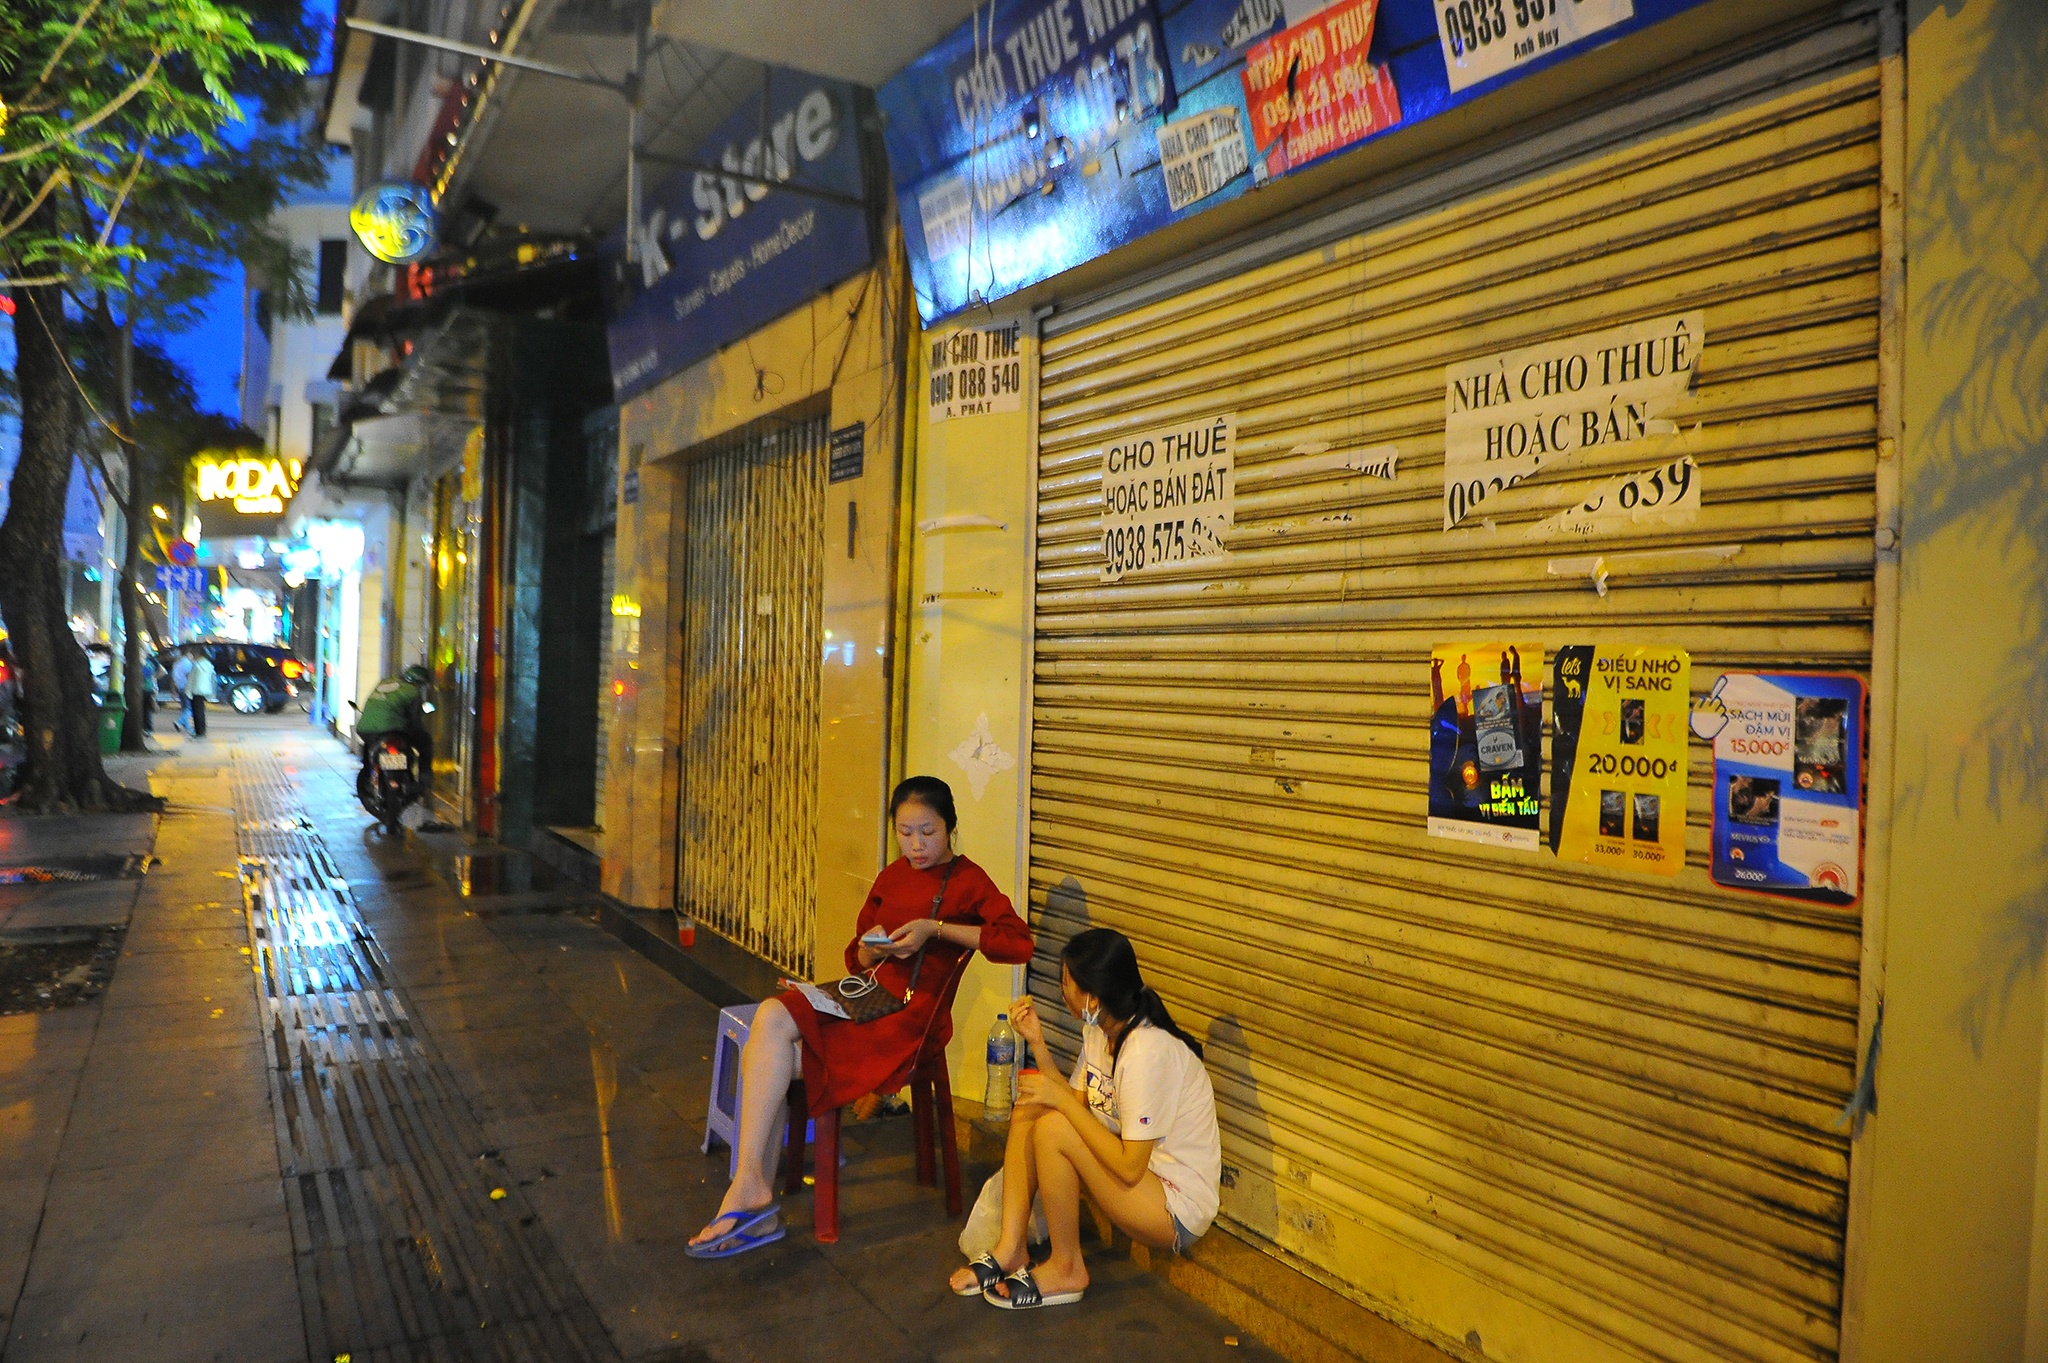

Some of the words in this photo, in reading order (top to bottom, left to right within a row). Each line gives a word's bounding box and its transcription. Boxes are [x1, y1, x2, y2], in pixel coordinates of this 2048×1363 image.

[1514, 36, 1535, 60] Anh
[1538, 27, 1559, 49] Huy
[952, 332, 978, 366] CHO
[985, 320, 1020, 360] THUÊ
[1451, 359, 1511, 413] NHÀ
[1520, 354, 1588, 400] CHO
[1597, 320, 1692, 386] THUÊ
[960, 366, 986, 400] 088
[992, 362, 1019, 396] 540
[961, 401, 992, 416] PHÁT
[1485, 413, 1570, 465] HOẶC
[1580, 395, 1647, 449] BÁN
[1108, 441, 1155, 475] CHO
[1162, 417, 1227, 464] THUÊ
[1106, 478, 1148, 521] HOẶC
[1153, 468, 1187, 510] BÁN
[1192, 462, 1227, 504] ĐẤT
[1105, 525, 1146, 575] 0938
[1642, 655, 1681, 674] NHỎ
[1603, 675, 1621, 694] VỊ
[1626, 676, 1673, 692] SANG
[1729, 708, 1763, 723] SẠCH
[1767, 709, 1791, 723] MÙI
[1779, 725, 1791, 740] VỊ
[1480, 742, 1514, 755] CRAVEN
[1588, 752, 1678, 779] 20,000đ
[1490, 772, 1525, 799] BẤM
[1517, 796, 1539, 816] TẤU
[1016, 1296, 1037, 1305] NIKE
